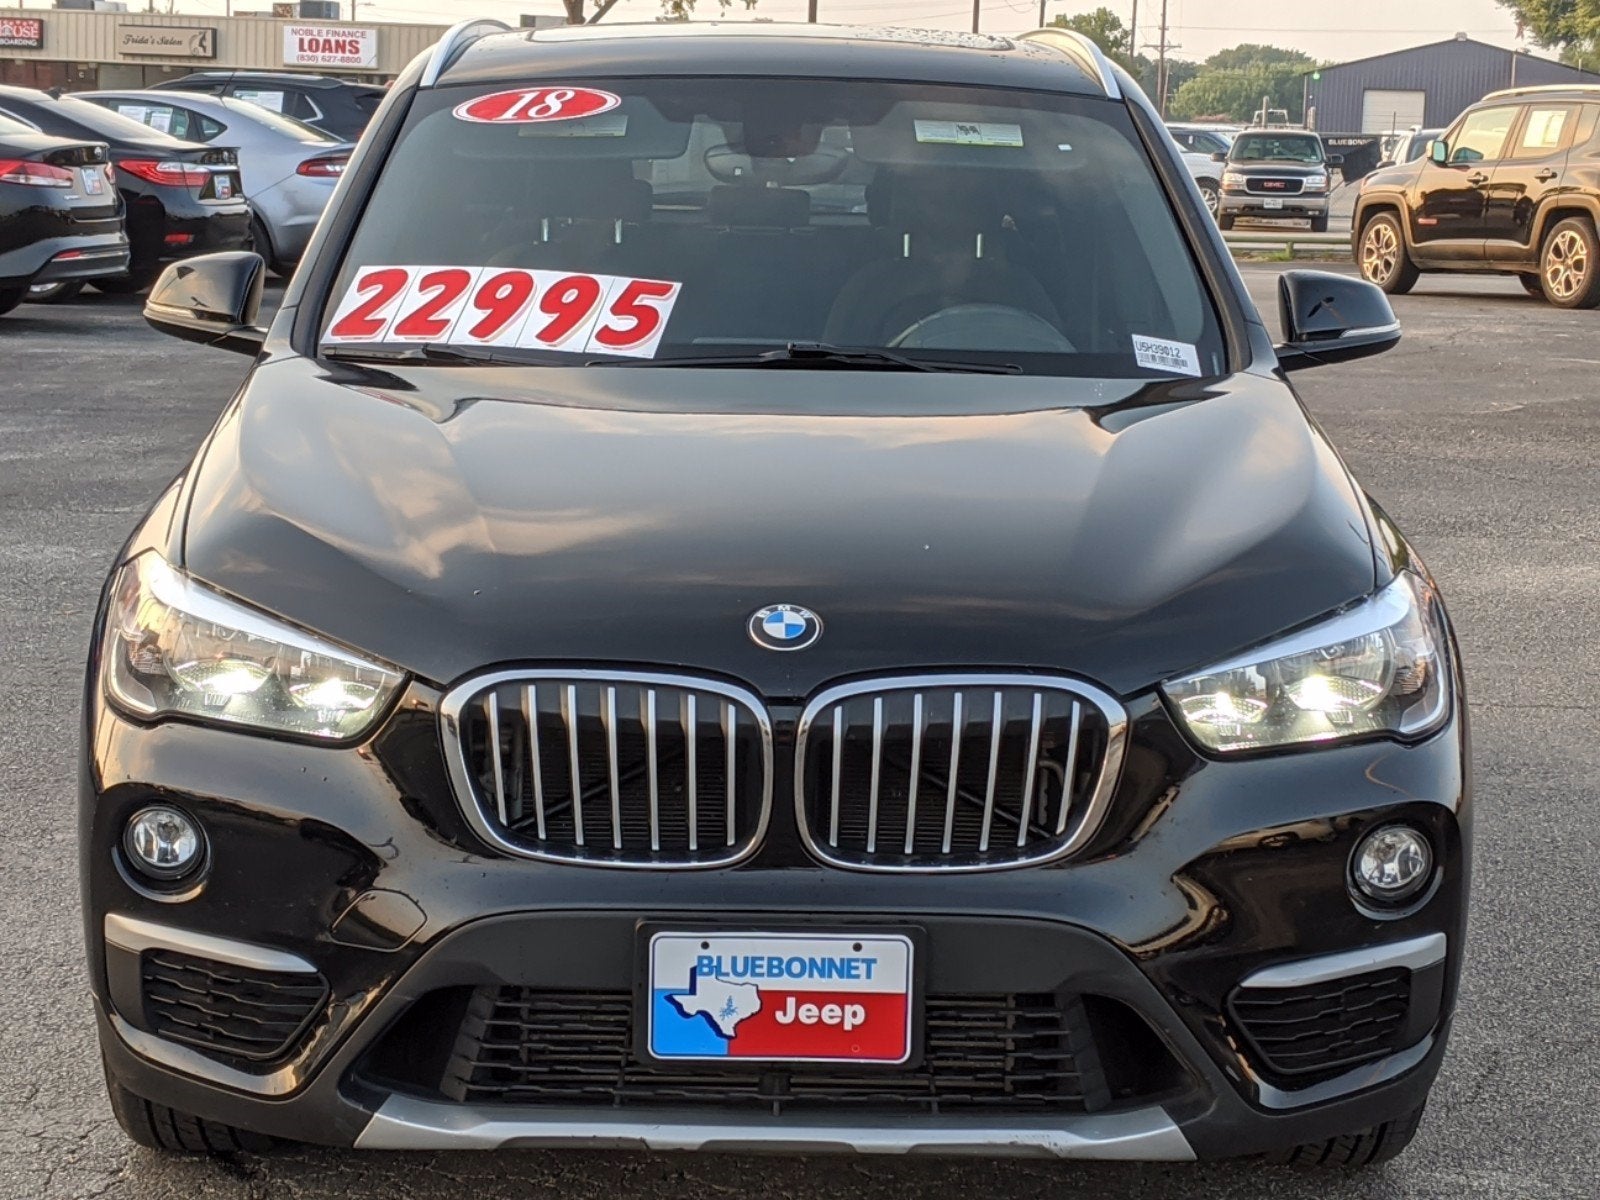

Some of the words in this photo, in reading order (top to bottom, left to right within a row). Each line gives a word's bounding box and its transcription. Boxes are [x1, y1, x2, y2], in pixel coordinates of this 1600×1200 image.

[291, 28, 323, 37] NOBLE
[326, 30, 367, 38] FINANCE
[298, 37, 360, 55] LOANS
[493, 89, 576, 121] 18
[330, 268, 676, 349] 22995
[697, 955, 877, 979] BLUEBONNET
[775, 996, 866, 1031] Jeep
